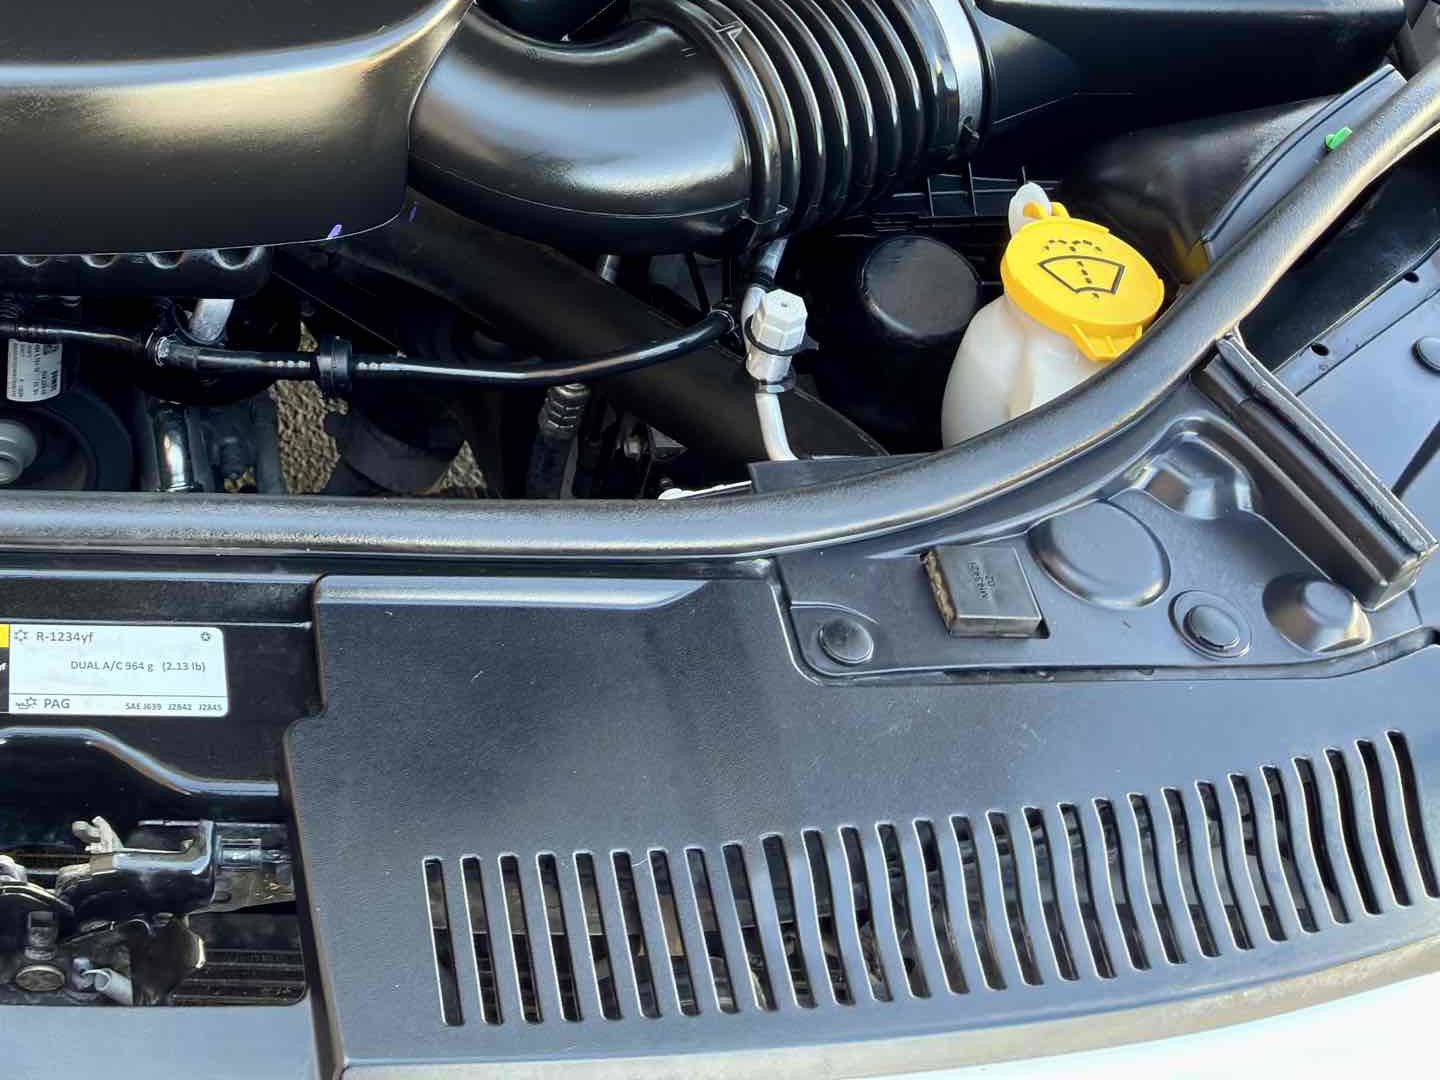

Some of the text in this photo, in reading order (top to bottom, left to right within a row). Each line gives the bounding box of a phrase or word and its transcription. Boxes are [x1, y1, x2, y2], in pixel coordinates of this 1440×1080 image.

[35, 631, 95, 645] R-1234yf
[70, 660, 101, 671] DUAL
[102, 660, 123, 672] A/C
[147, 662, 154, 673] g
[162, 661, 190, 673] (2.13
[191, 661, 206, 673] lb)
[43, 697, 71, 710] PAG
